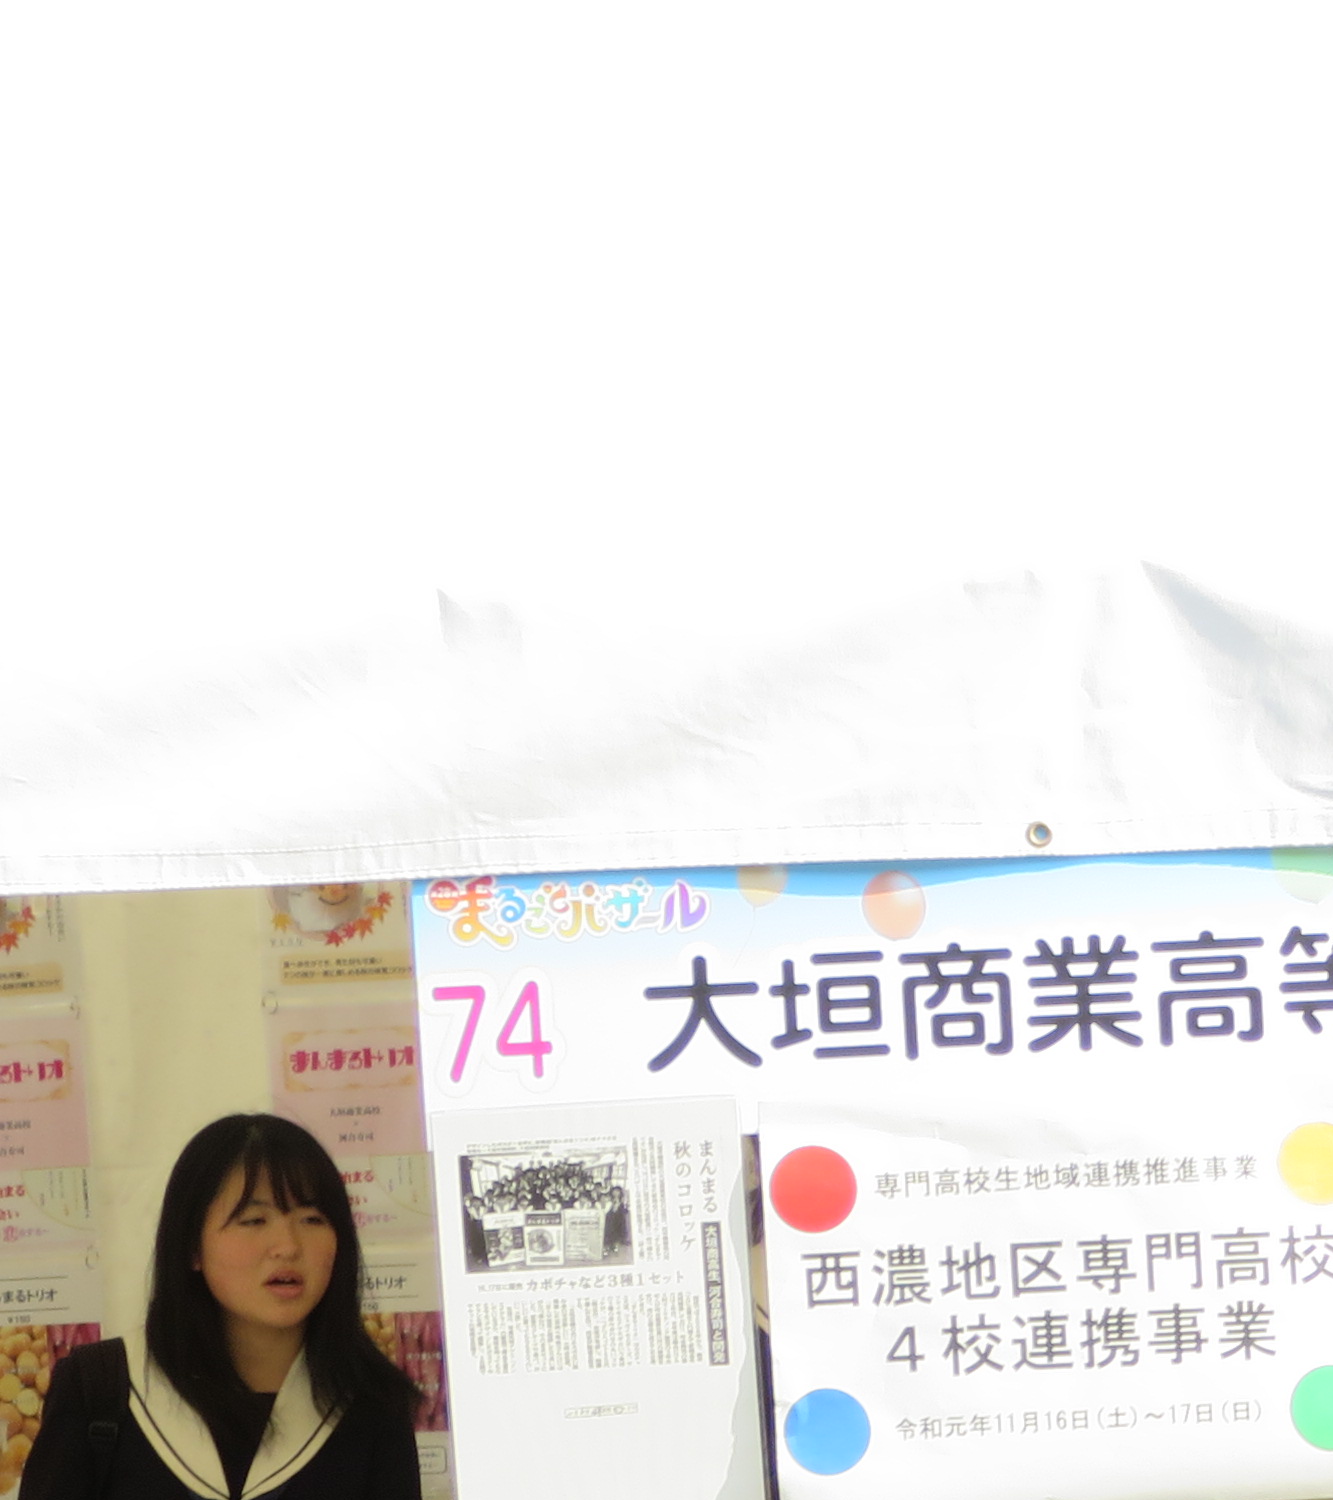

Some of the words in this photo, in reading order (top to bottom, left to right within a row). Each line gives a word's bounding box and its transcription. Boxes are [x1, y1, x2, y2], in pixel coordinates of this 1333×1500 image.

[453, 876, 707, 946] まるごとバザール
[432, 980, 552, 1082] 74
[674, 1141, 696, 1252] 秋のコロッケ
[699, 1140, 718, 1213] まんまる
[874, 1153, 1258, 1199] 専門高校生地域連携推進事業
[886, 1300, 1276, 1377] ４校連携事業
